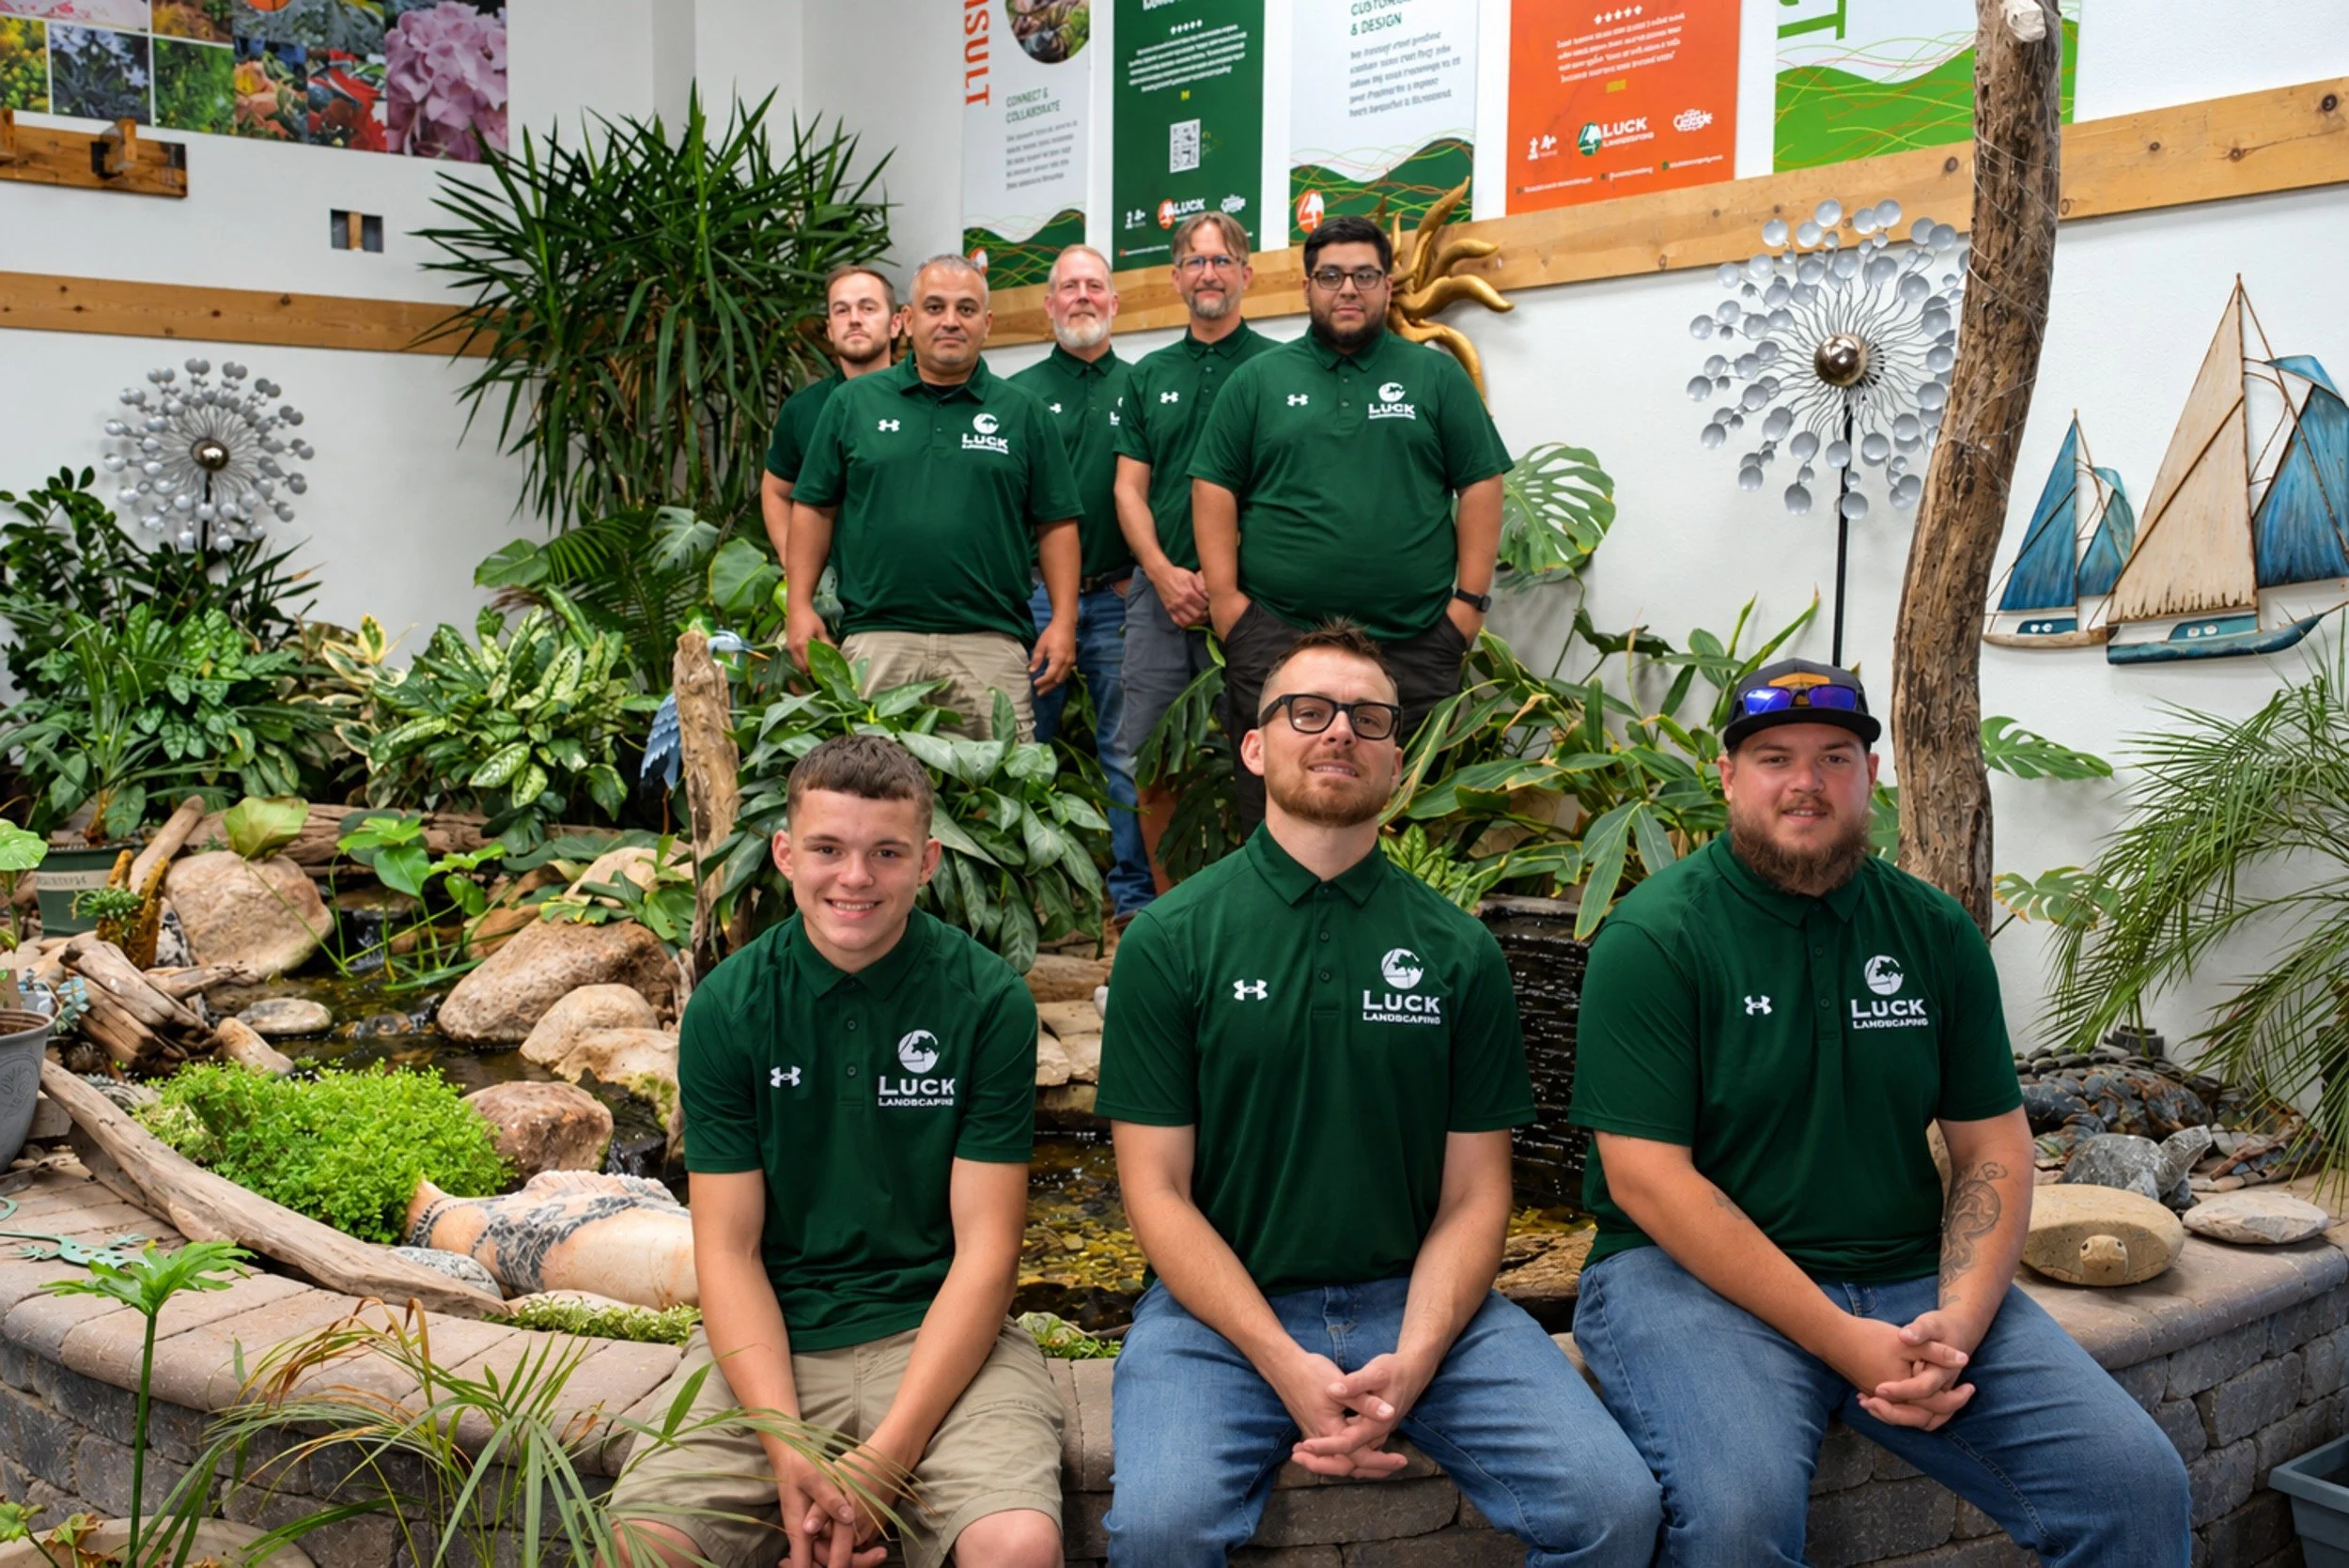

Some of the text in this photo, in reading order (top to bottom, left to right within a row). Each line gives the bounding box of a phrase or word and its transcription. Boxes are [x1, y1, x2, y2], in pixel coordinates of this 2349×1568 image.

[1361, 11, 1403, 35] DESIGN
[1006, 88, 1042, 108] CONNECT
[1601, 116, 1648, 138] LUCK
[1173, 197, 1206, 215] LUCK
[1368, 402, 1416, 415] LUCK
[961, 432, 1009, 450] LUCK
[1362, 989, 1441, 1015] LUCK
[1850, 998, 1927, 1018] LUCK
[878, 1075, 957, 1096] LUCK
